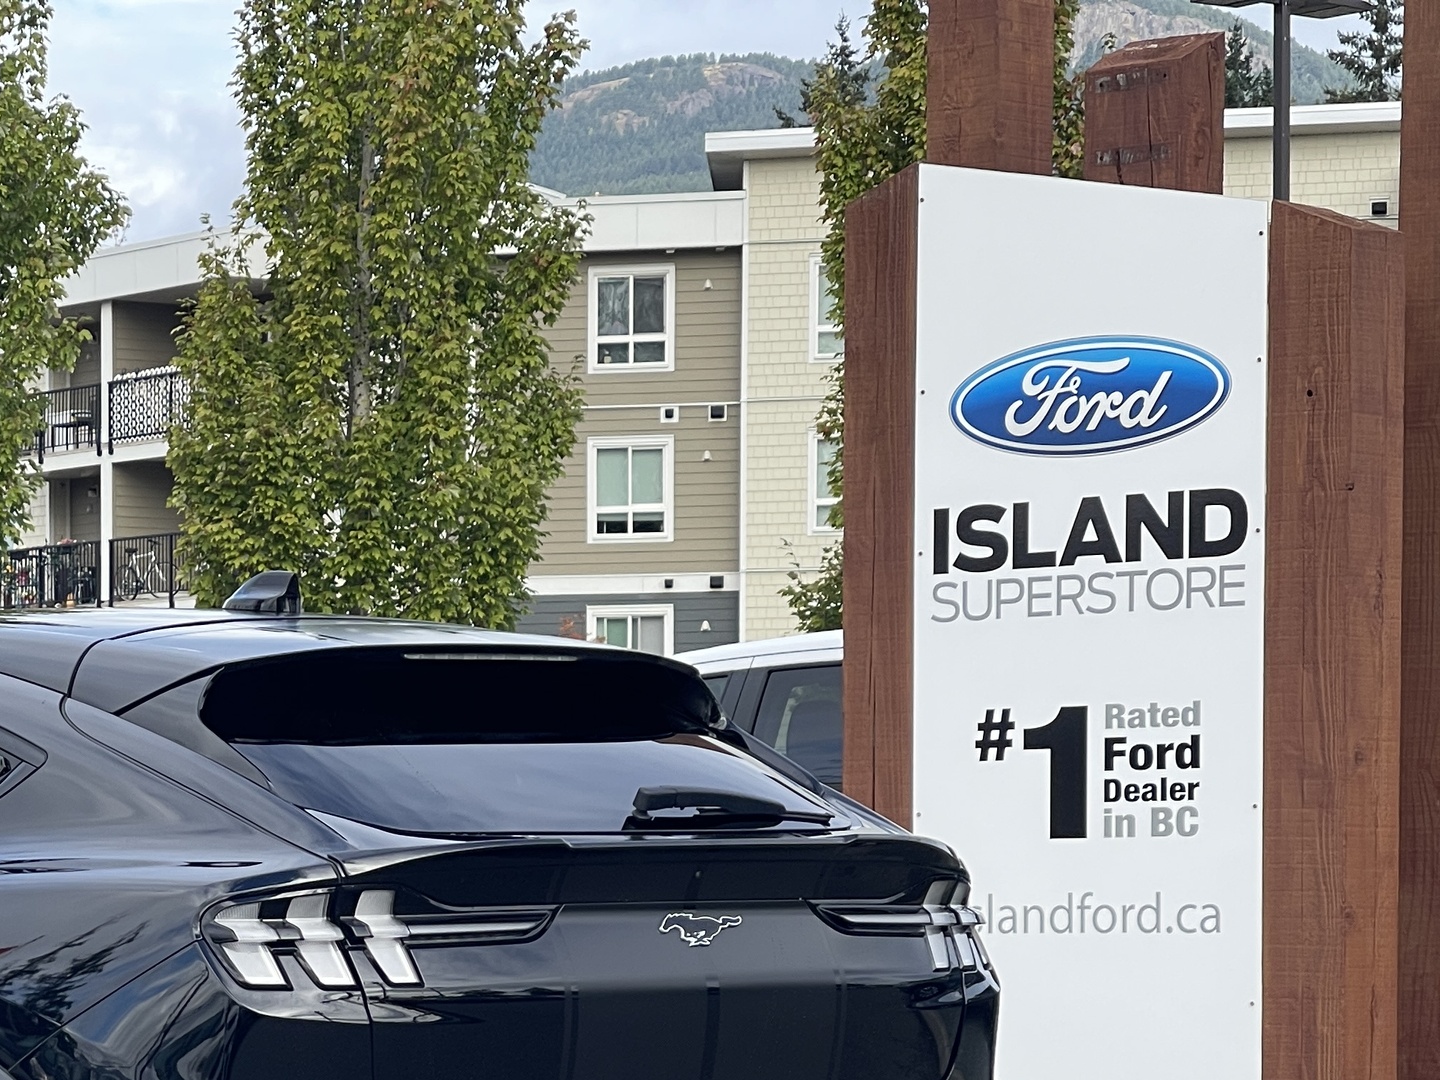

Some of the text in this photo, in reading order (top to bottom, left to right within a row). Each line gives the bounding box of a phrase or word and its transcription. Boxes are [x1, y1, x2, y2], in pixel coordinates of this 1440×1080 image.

[1004, 356, 1173, 437] Ford
[933, 488, 1249, 575] ISLAND
[930, 564, 1247, 623] SUPERSTORE
[1104, 700, 1202, 730] Rated
[974, 705, 1089, 840] #1
[1103, 734, 1201, 771] Ford
[1103, 777, 1201, 803] Dealer
[1103, 805, 1200, 838] in BC
